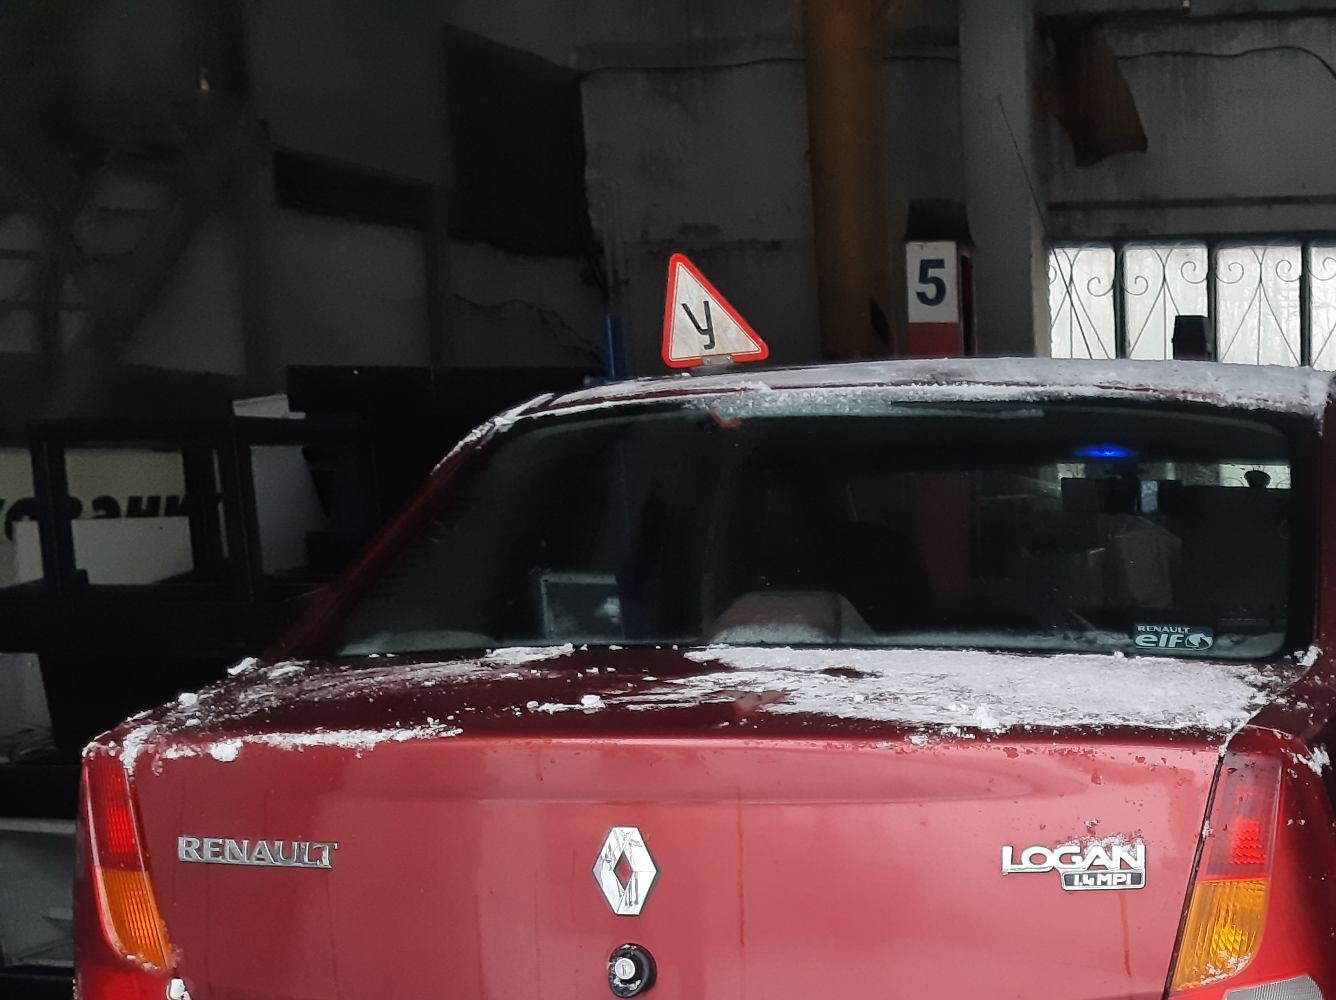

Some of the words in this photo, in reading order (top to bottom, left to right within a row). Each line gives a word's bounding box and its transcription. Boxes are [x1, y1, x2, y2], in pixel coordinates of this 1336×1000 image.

[916, 259, 946, 306] 5
[178, 836, 339, 867] RENAULT
[1001, 844, 1145, 871] LOGAN
